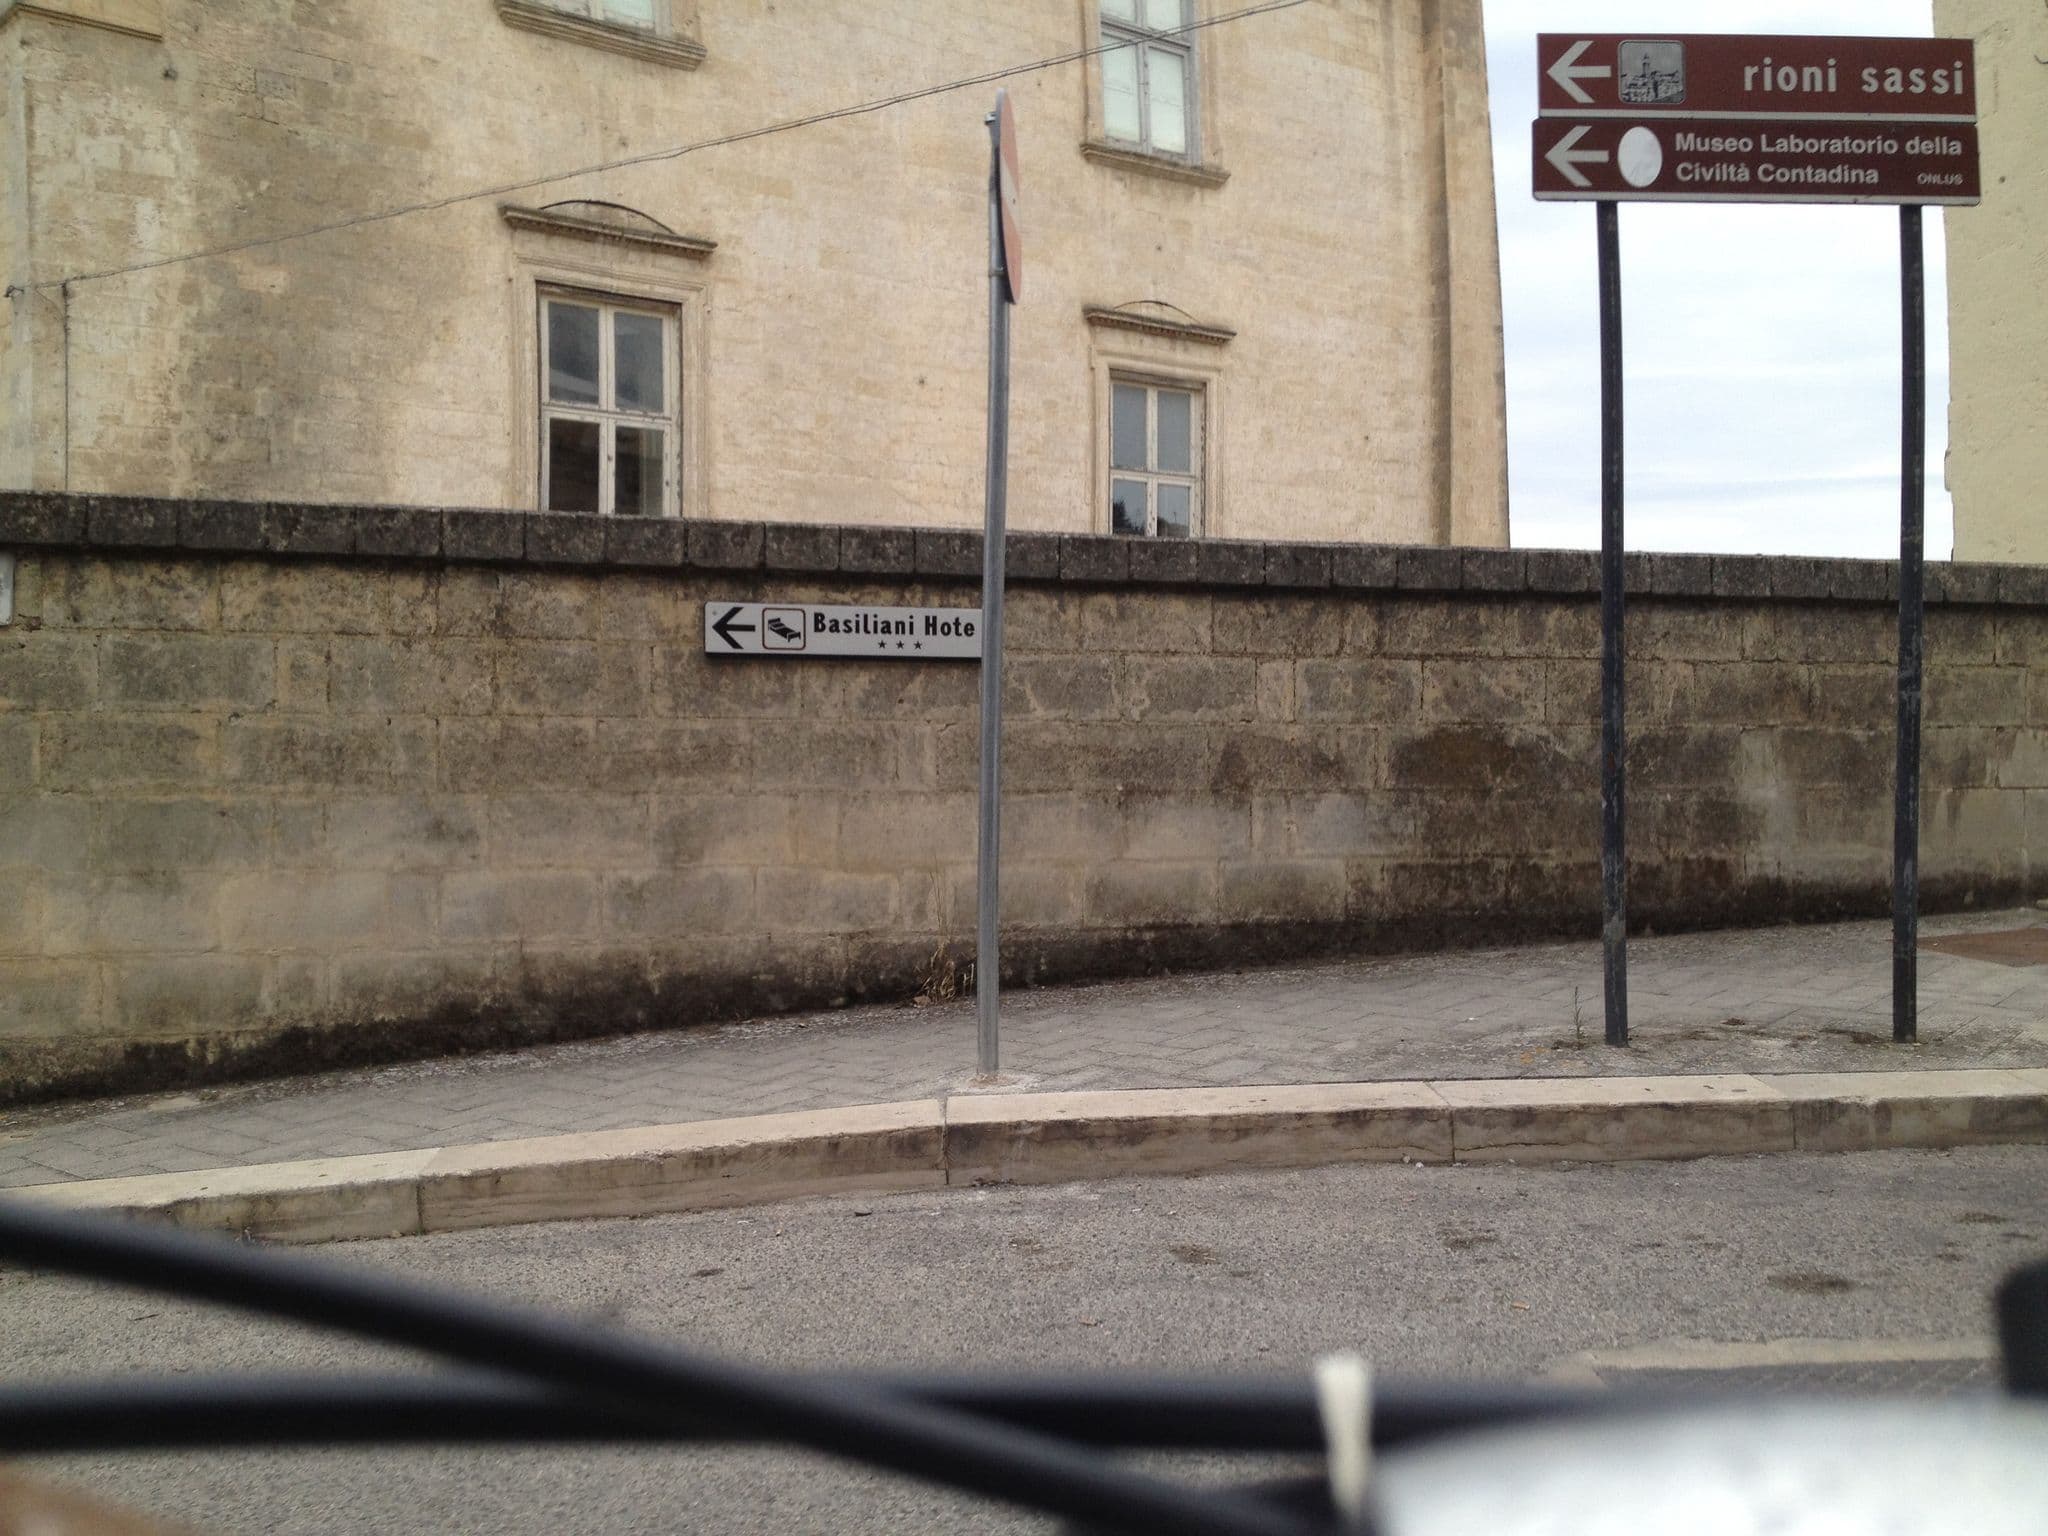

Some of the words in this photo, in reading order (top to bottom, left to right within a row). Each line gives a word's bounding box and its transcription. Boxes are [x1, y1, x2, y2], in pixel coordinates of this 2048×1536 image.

[1744, 57, 1836, 92] rioni
[1862, 61, 1963, 94] sassi
[1675, 133, 1753, 152] Museo
[1760, 134, 1898, 154] Laboratorio
[1905, 136, 1962, 155] della
[1676, 163, 1750, 182] Civiltà
[1757, 164, 1878, 183] Contadina
[1917, 173, 1963, 185] ONLUS
[813, 612, 914, 635] Basiliani
[924, 615, 976, 637] Hote
